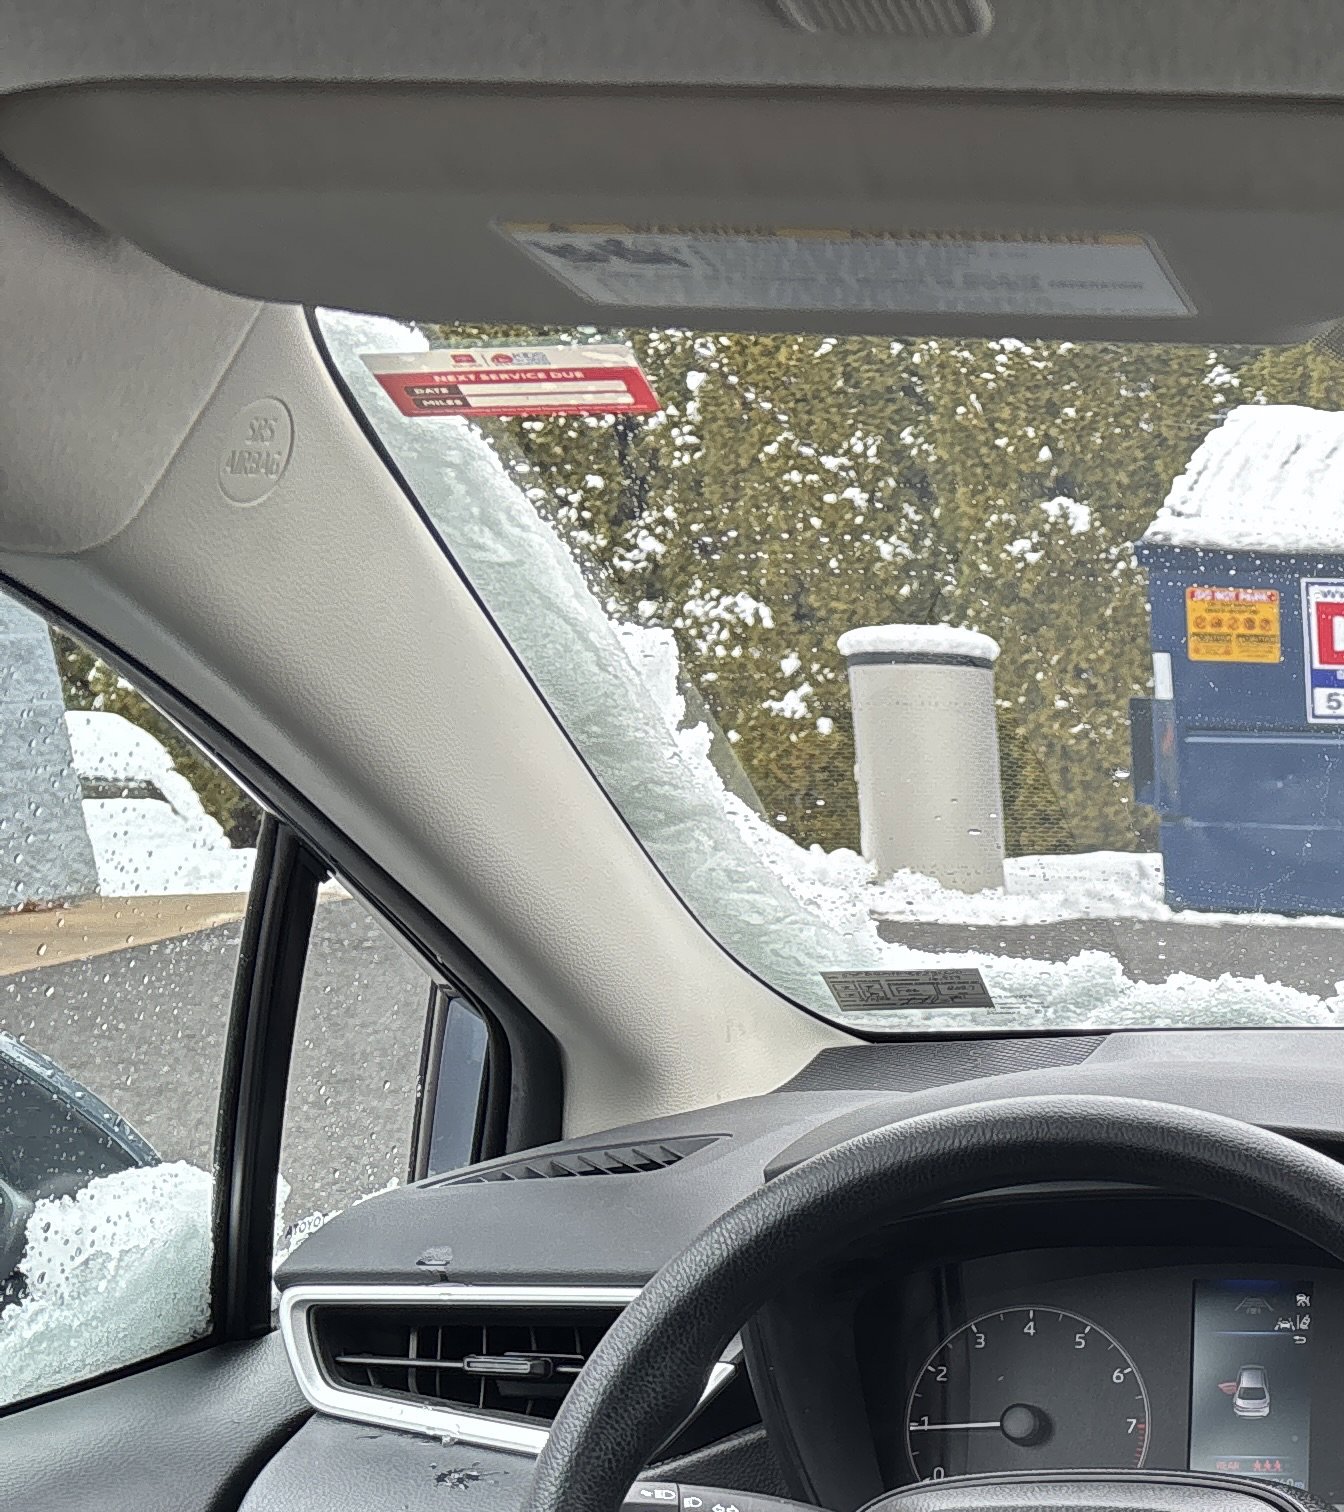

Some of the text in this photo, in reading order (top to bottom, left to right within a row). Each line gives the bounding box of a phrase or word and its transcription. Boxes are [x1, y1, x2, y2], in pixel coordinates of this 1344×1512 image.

[433, 371, 585, 383] NEXT SERVICE DUE
[413, 387, 449, 395] DATE
[1023, 1321, 1036, 1336] 4
[974, 1333, 986, 1349] 3
[1074, 1333, 1086, 1349] 5
[935, 1366, 948, 1382] 2
[1112, 1368, 1125, 1384] 6
[919, 1416, 930, 1431] 1
[1126, 1418, 1138, 1434] 7
